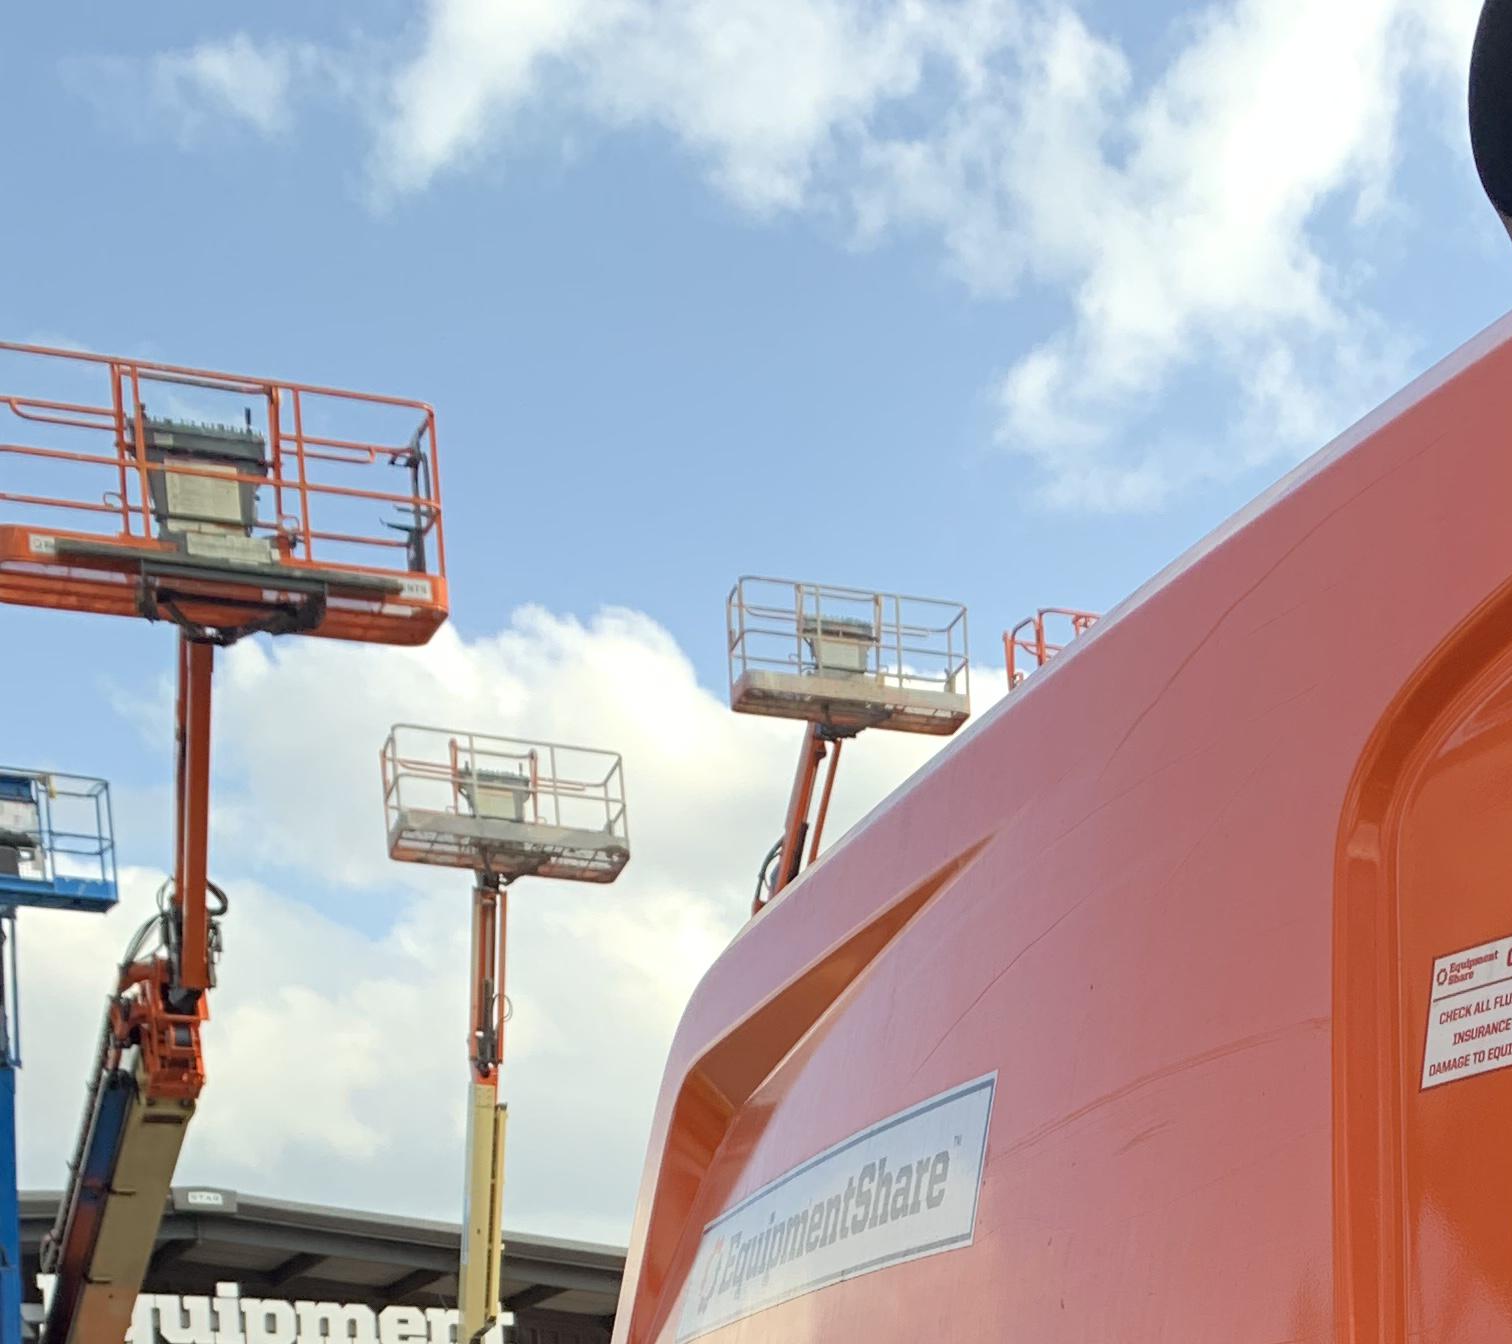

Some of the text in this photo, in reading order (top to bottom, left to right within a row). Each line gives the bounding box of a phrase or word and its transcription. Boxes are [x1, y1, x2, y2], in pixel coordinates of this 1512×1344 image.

[1450, 950, 1499, 971] Equipment
[1448, 971, 1475, 985] Share
[1439, 1002, 1472, 1025] CHECK
[1474, 999, 1492, 1015] ALL
[1453, 1018, 1511, 1046] INSURANCE
[1429, 1054, 1470, 1077] DAMAGE
[1473, 1050, 1485, 1063] TO
[717, 1150, 951, 1300] EquipmentShare
